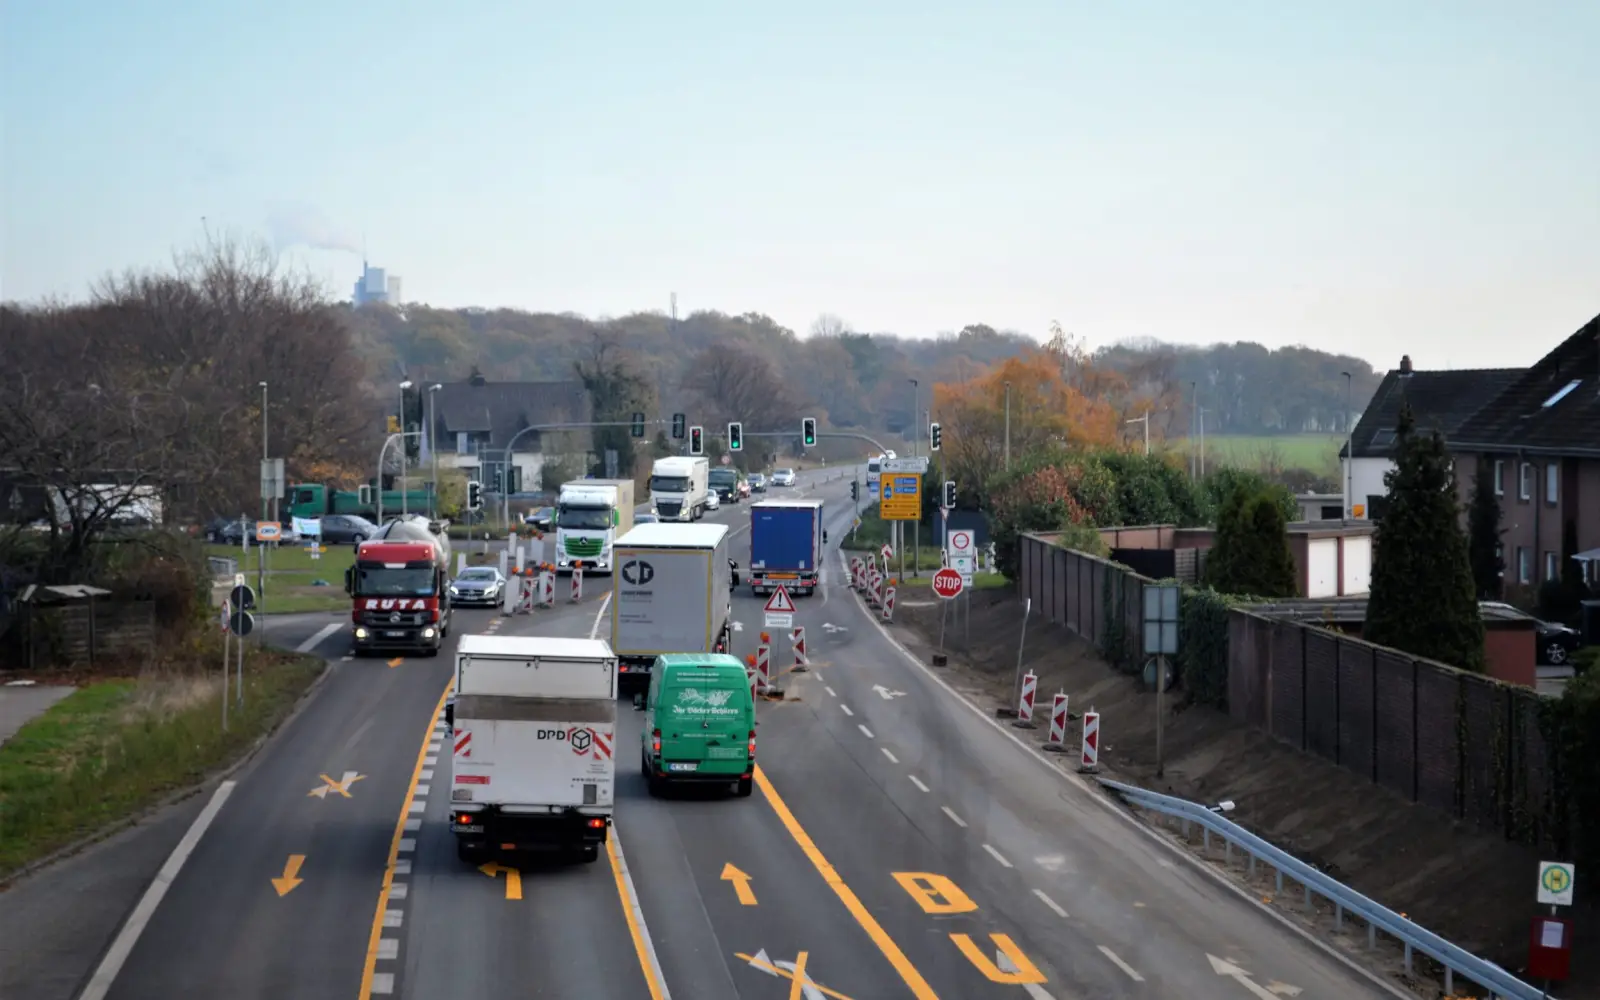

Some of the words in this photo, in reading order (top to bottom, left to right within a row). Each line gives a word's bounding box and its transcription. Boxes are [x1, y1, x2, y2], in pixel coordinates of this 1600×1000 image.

[935, 576, 960, 590] STOP
[365, 599, 426, 610] RUTA
[537, 730, 566, 740] DPD
[1550, 872, 1563, 890] H
